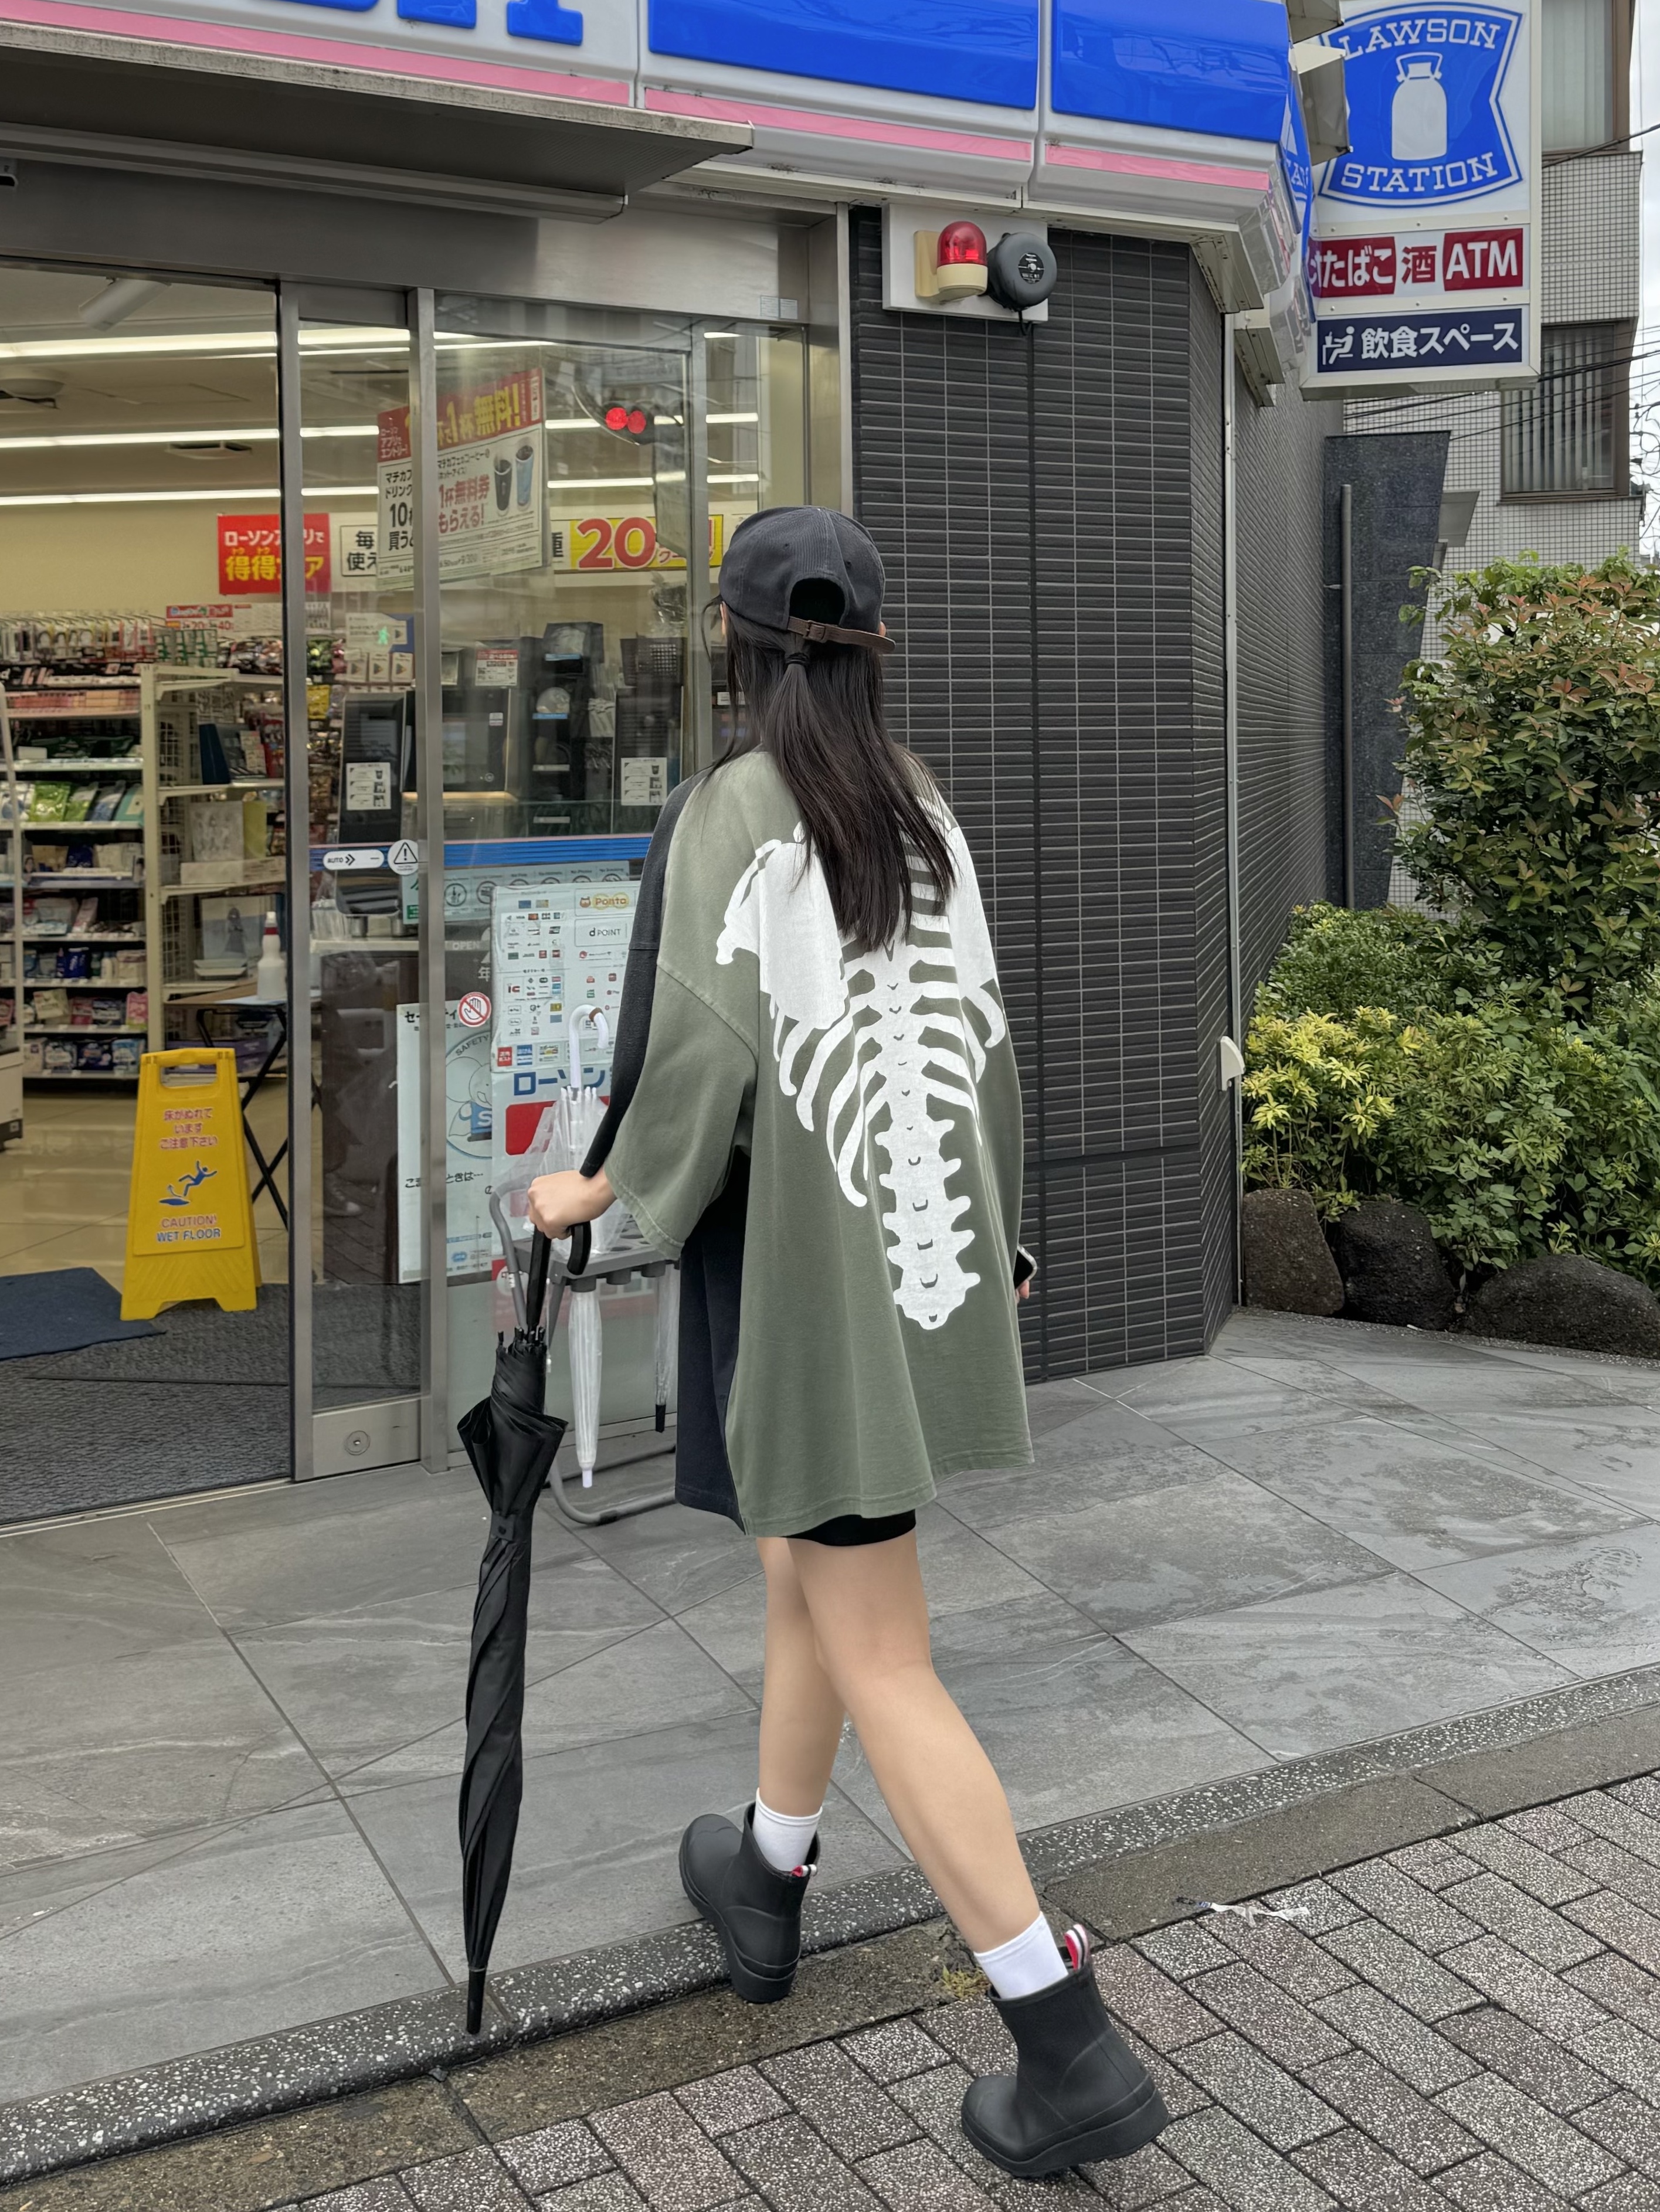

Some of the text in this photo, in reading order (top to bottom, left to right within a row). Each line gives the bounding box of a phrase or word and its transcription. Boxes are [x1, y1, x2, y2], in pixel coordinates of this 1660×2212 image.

[1339, 19, 1501, 60] LAWSON
[1341, 152, 1498, 192] STATION
[1320, 239, 1518, 288] たばこ 酒 ATM
[1362, 322, 1519, 359] 飲食スペース
[385, 470, 412, 483] マチカフ
[224, 529, 324, 546] ローソンリで
[577, 517, 656, 569] 20
[226, 555, 324, 581] 得得ア
[595, 896, 627, 906] Ponta
[452, 940, 481, 950] OPEN
[456, 1034, 489, 1056] SAFETY
[161, 1214, 217, 1228] CAUTION!
[157, 1228, 220, 1242] WET FLOOR
